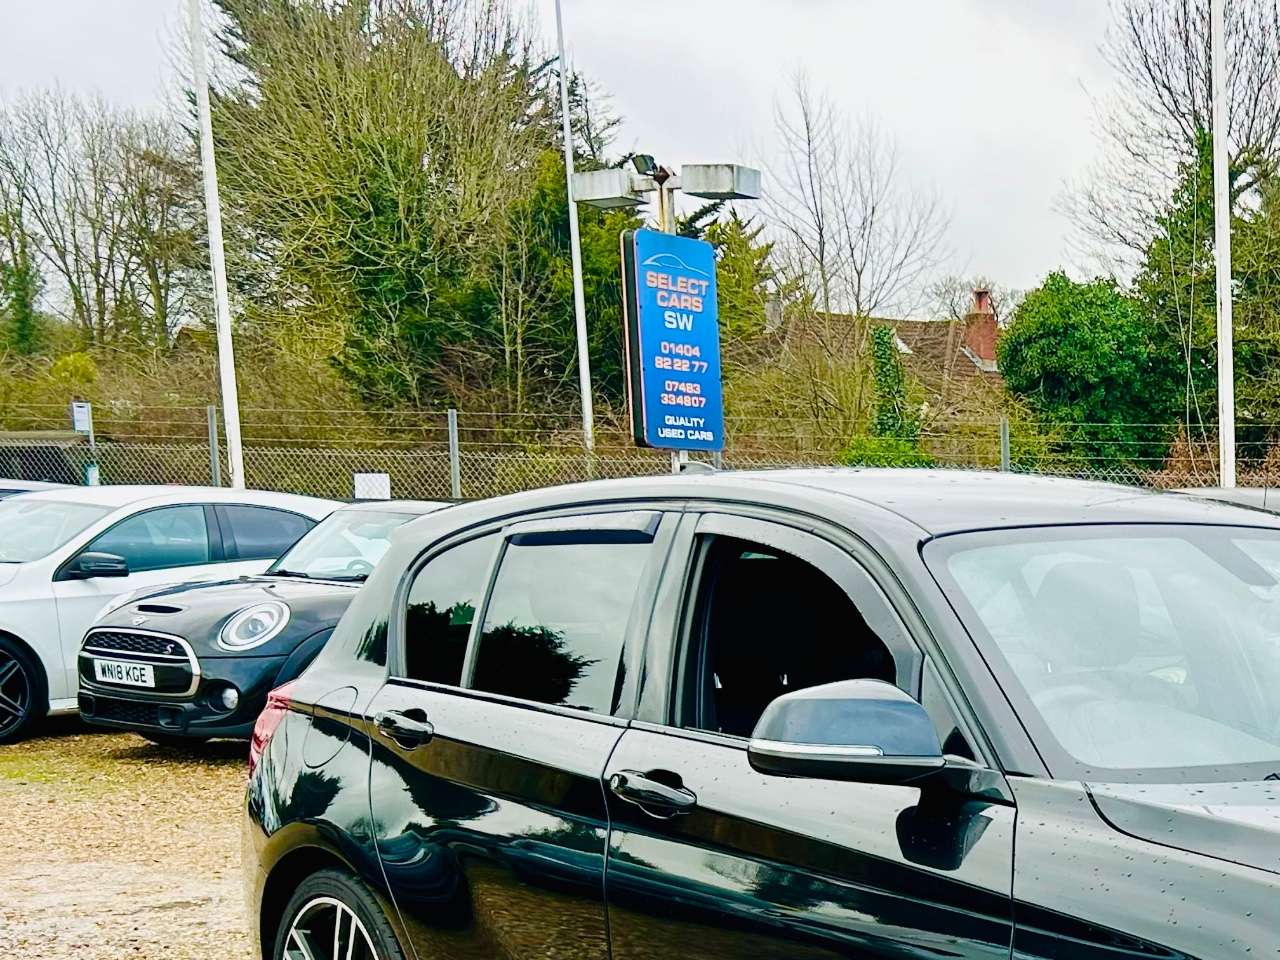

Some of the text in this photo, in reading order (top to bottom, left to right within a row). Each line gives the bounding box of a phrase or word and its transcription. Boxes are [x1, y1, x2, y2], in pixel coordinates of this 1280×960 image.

[646, 271, 709, 296] SELECT
[656, 290, 703, 312] CARS
[664, 310, 694, 331] SW
[660, 341, 701, 357] 01404
[664, 415, 705, 428] QUALITY
[658, 427, 714, 441] USED CARS
[99, 663, 147, 683] WN18 KGE
